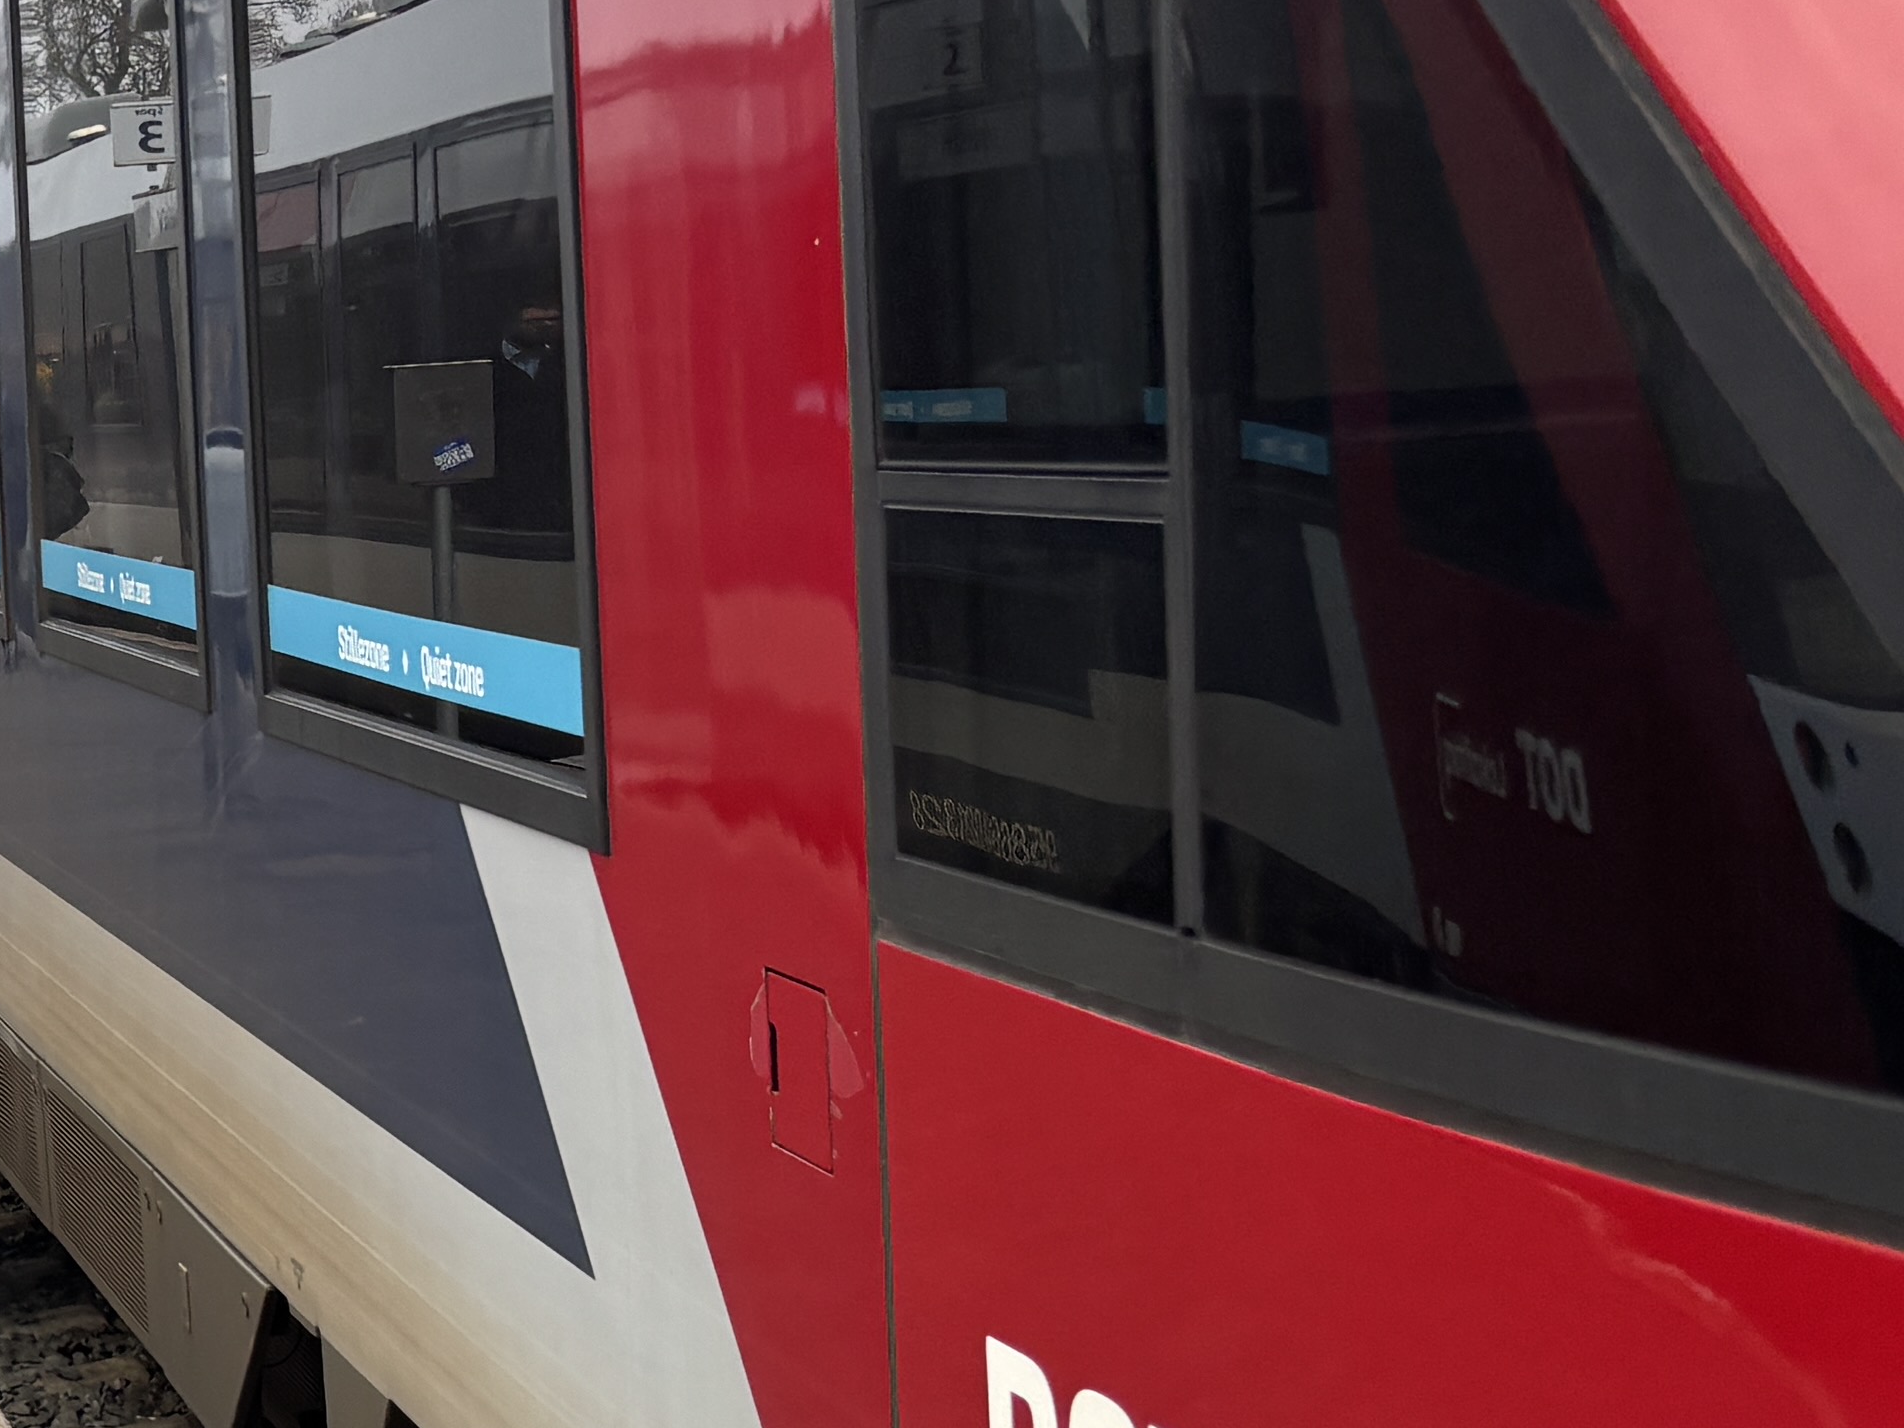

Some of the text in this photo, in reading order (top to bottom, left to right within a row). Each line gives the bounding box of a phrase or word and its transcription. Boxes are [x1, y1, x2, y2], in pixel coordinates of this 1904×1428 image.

[337, 624, 485, 698] Stillezone Quiet zone
